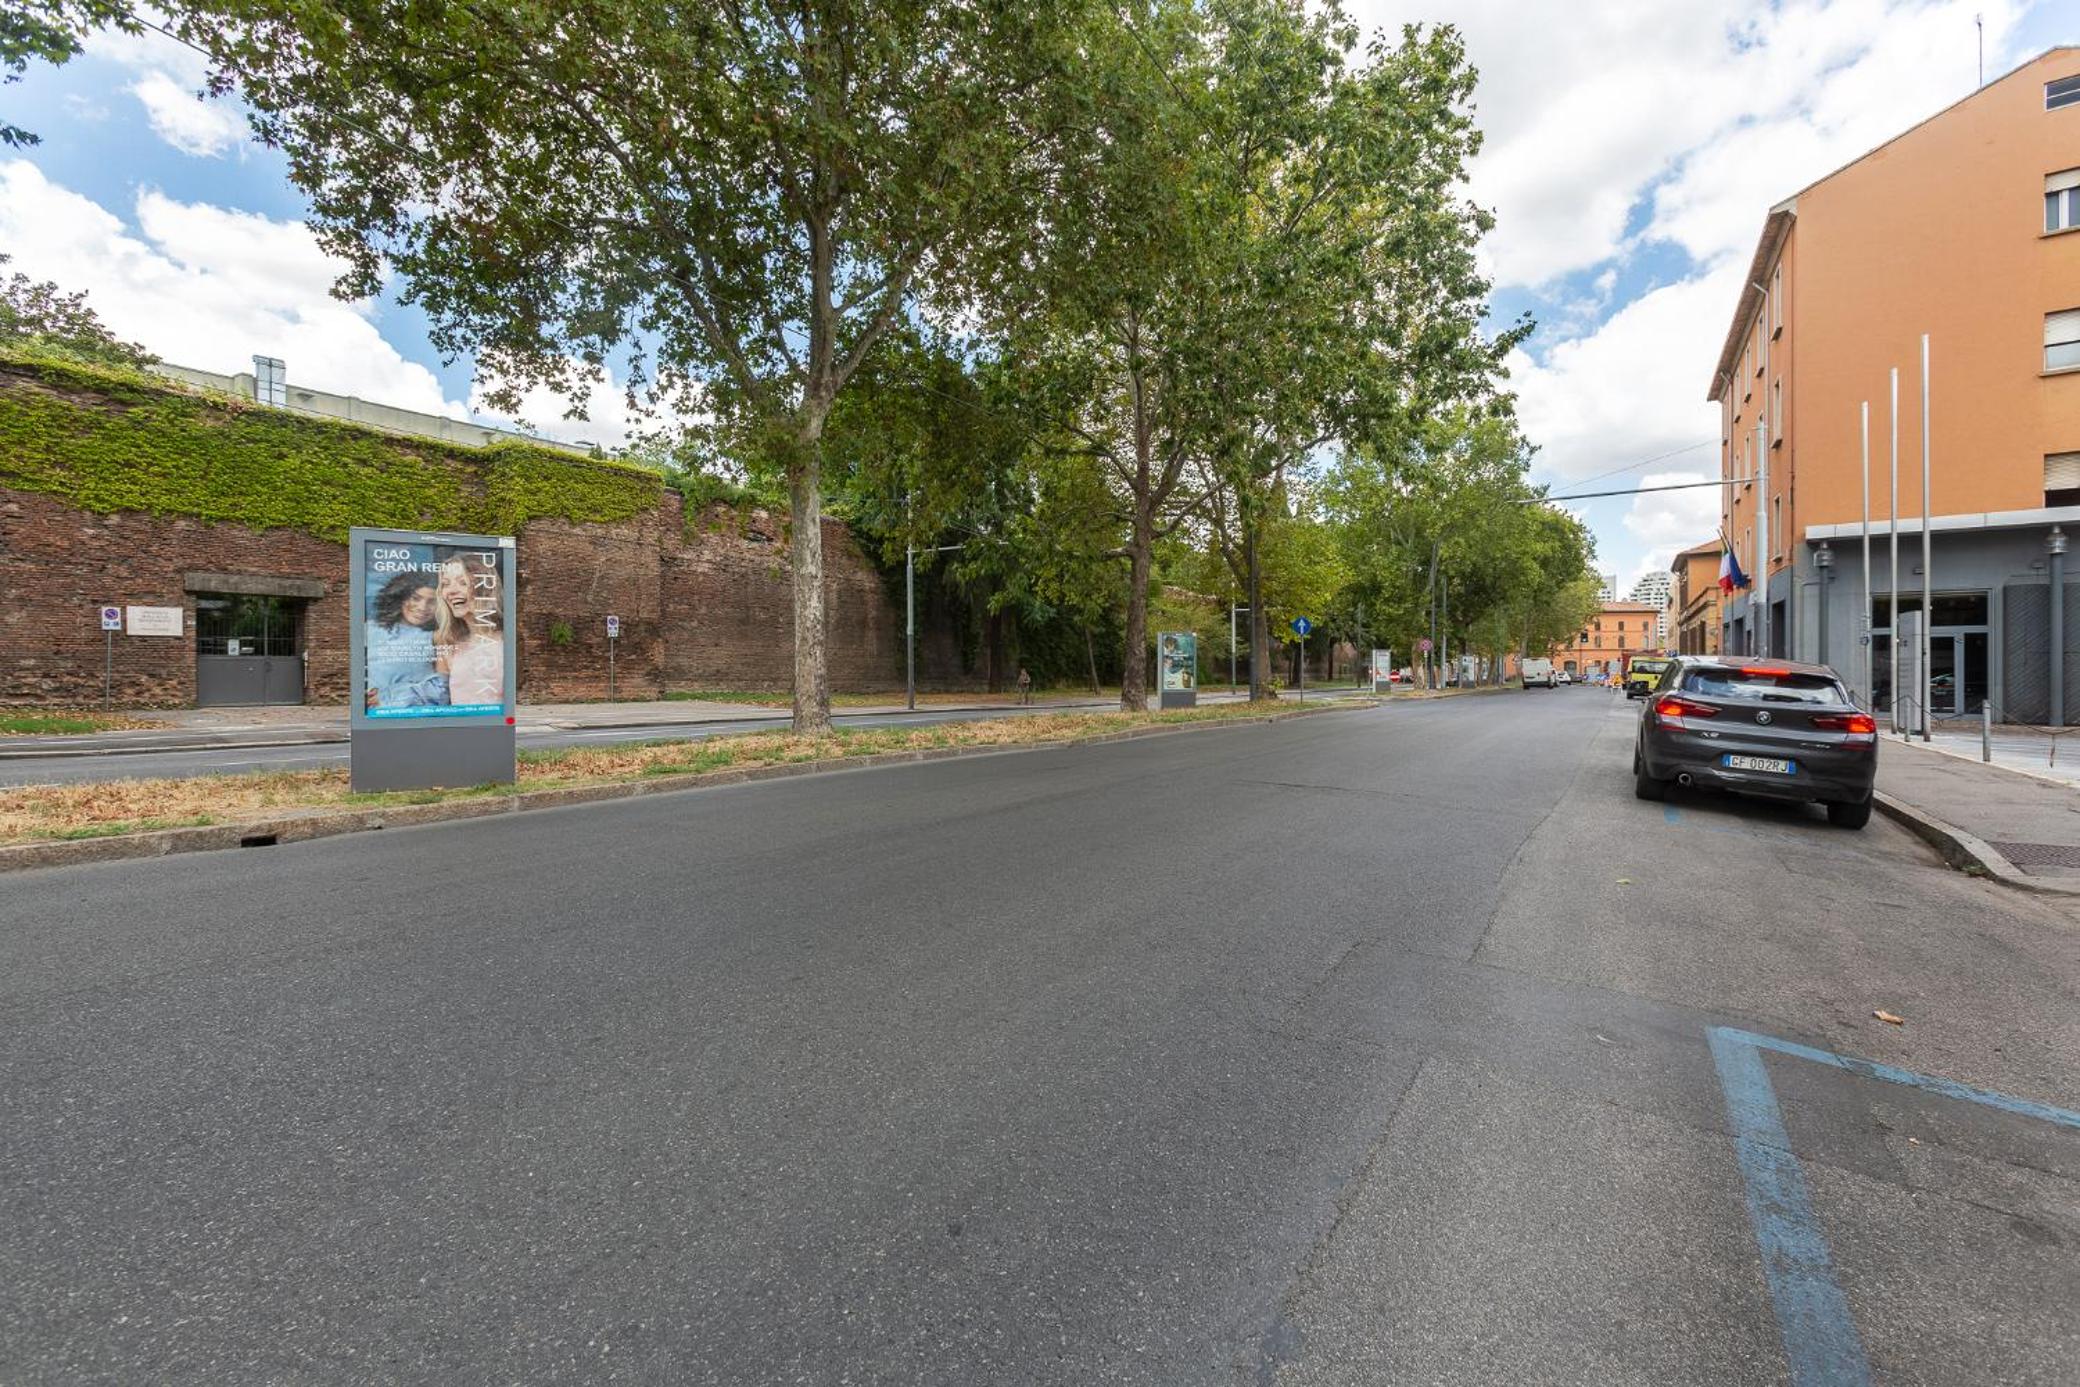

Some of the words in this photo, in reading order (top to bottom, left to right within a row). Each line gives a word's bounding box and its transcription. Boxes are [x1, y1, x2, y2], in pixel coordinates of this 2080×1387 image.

[373, 548, 410, 560] CIAO
[374, 561, 417, 573] GRAN
[472, 551, 498, 694] PRIMARK
